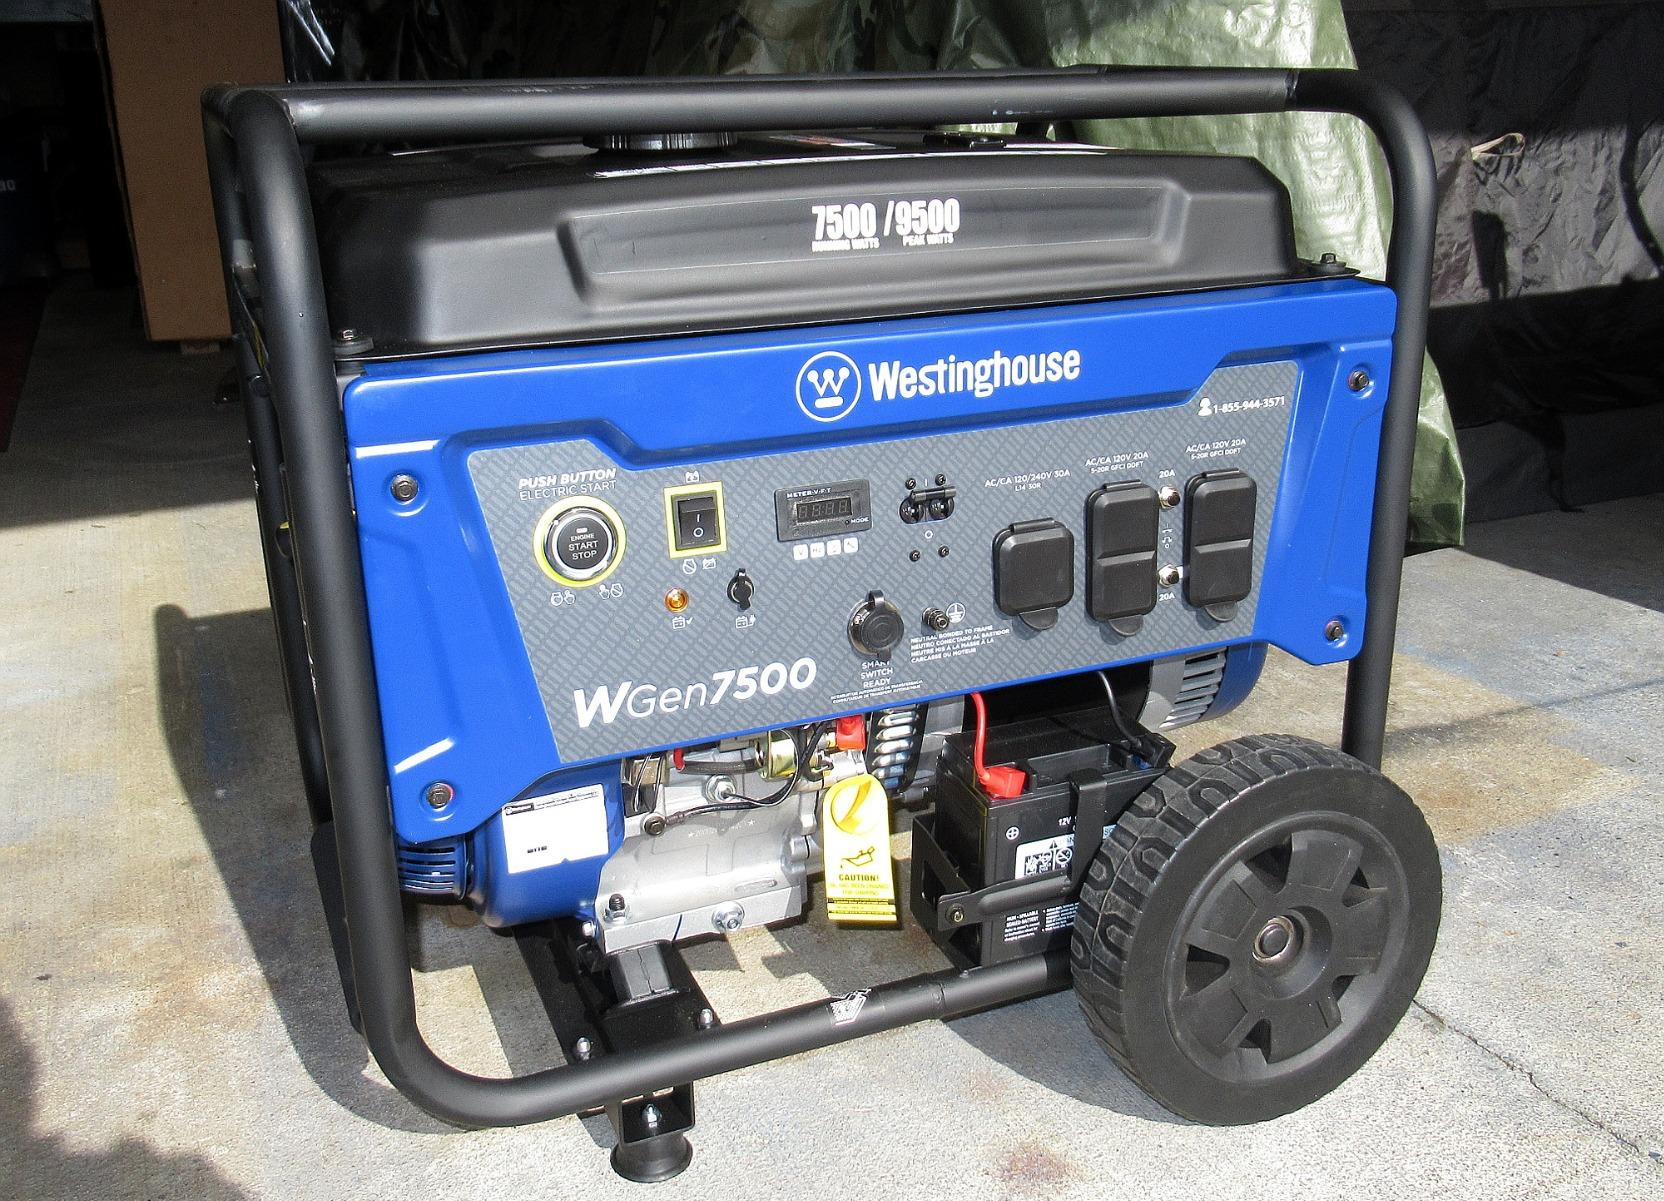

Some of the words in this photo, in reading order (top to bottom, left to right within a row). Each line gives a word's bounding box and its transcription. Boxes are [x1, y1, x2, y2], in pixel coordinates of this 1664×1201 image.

[811, 202, 877, 241] 7500
[868, 349, 1081, 402] Westinghouse
[1213, 395, 1285, 414] 1-855-944-3571
[1185, 443, 1211, 453] AC/CA
[1212, 440, 1230, 449] 120V
[1231, 438, 1247, 447] 20A
[1085, 456, 1111, 467] AC/CA
[1113, 453, 1131, 463] 120V
[1133, 451, 1149, 460] 20A
[518, 474, 557, 490] PUSH
[560, 468, 617, 484] BUTTON
[984, 476, 1012, 488] AC/CA
[1014, 470, 1052, 484] 120/240V
[1053, 468, 1071, 478] 30A
[1159, 469, 1176, 479] 20A
[519, 484, 578, 501] ELECTRIC
[580, 479, 617, 494] START
[850, 516, 870, 524] MODE
[570, 532, 595, 542] ENGINE
[568, 540, 599, 552] START
[571, 549, 598, 561] STOP
[1159, 591, 1176, 602] 20A
[860, 667, 894, 680] SWITCH
[863, 677, 892, 689] READY
[573, 656, 818, 728] WGen7500
[1058, 815, 1072, 826] 12V
